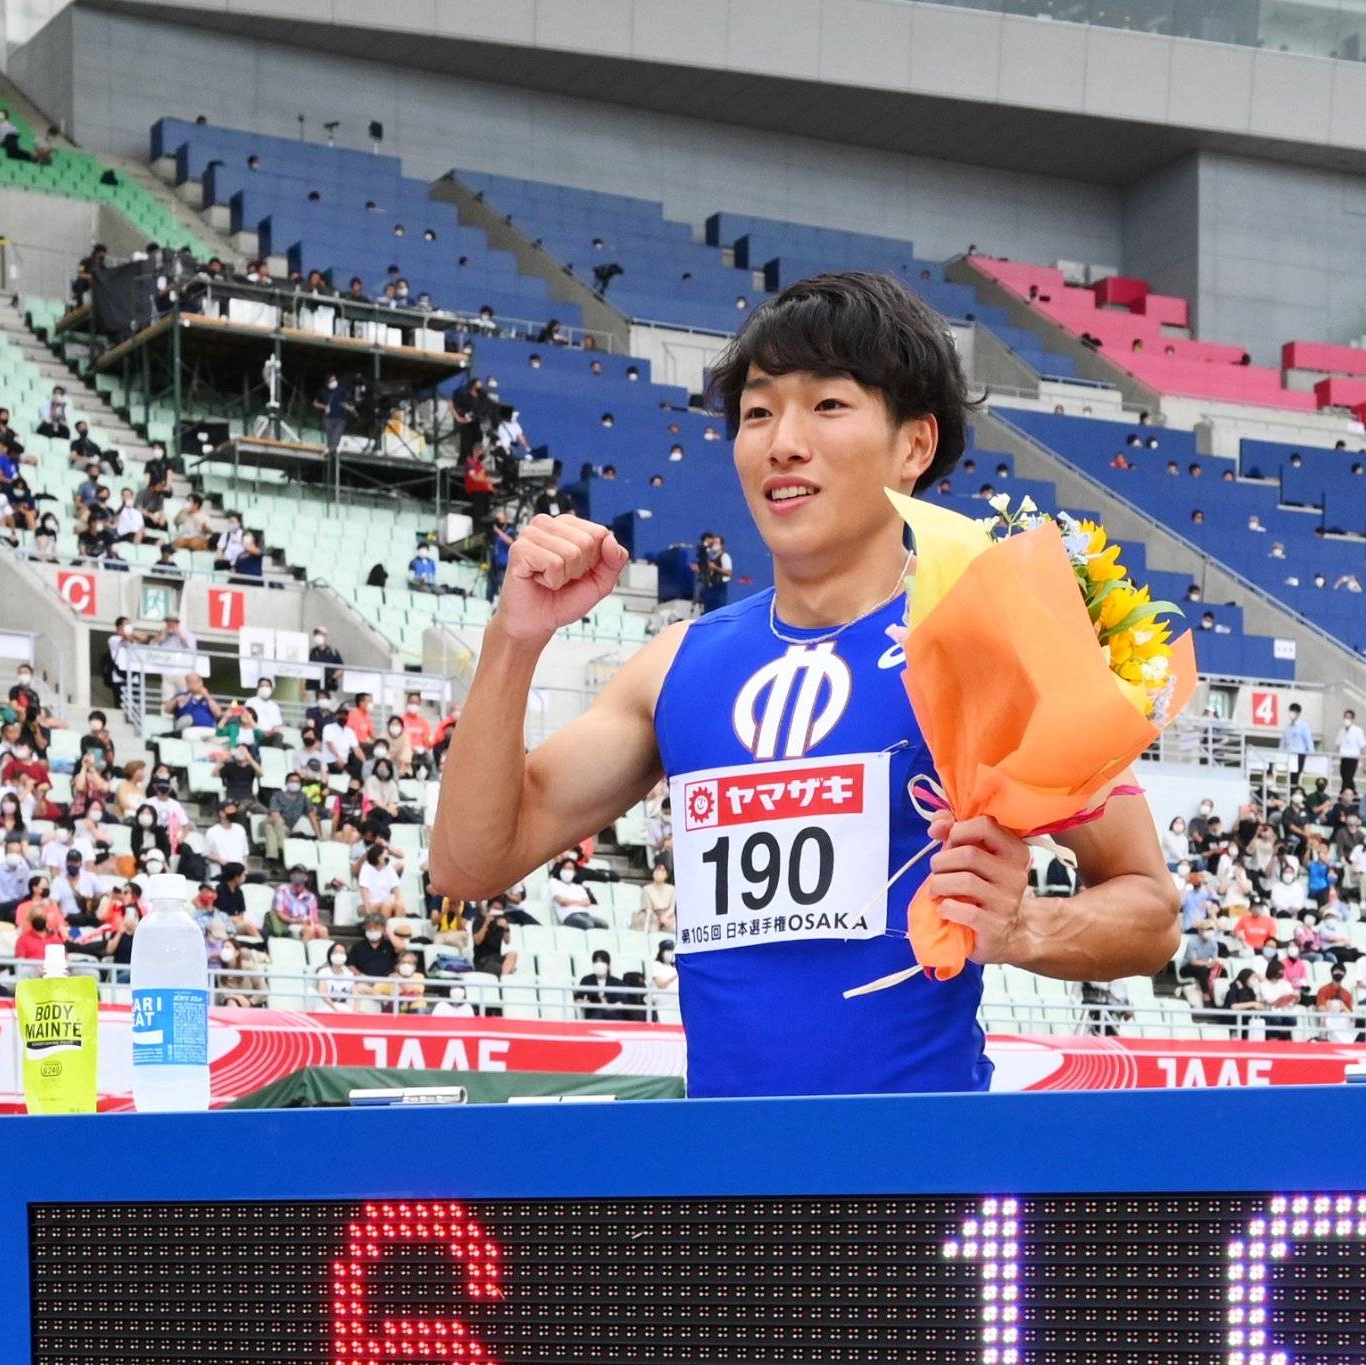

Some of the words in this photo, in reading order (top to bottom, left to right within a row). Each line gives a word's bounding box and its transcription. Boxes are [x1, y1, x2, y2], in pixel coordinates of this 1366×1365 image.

[61, 574, 91, 612] C
[217, 592, 232, 628] 1
[1256, 693, 1275, 725] 4
[725, 775, 854, 815] ヤマザキ
[702, 826, 835, 916] 190
[681, 924, 722, 945] 第105回
[35, 1004, 74, 1021] BODY
